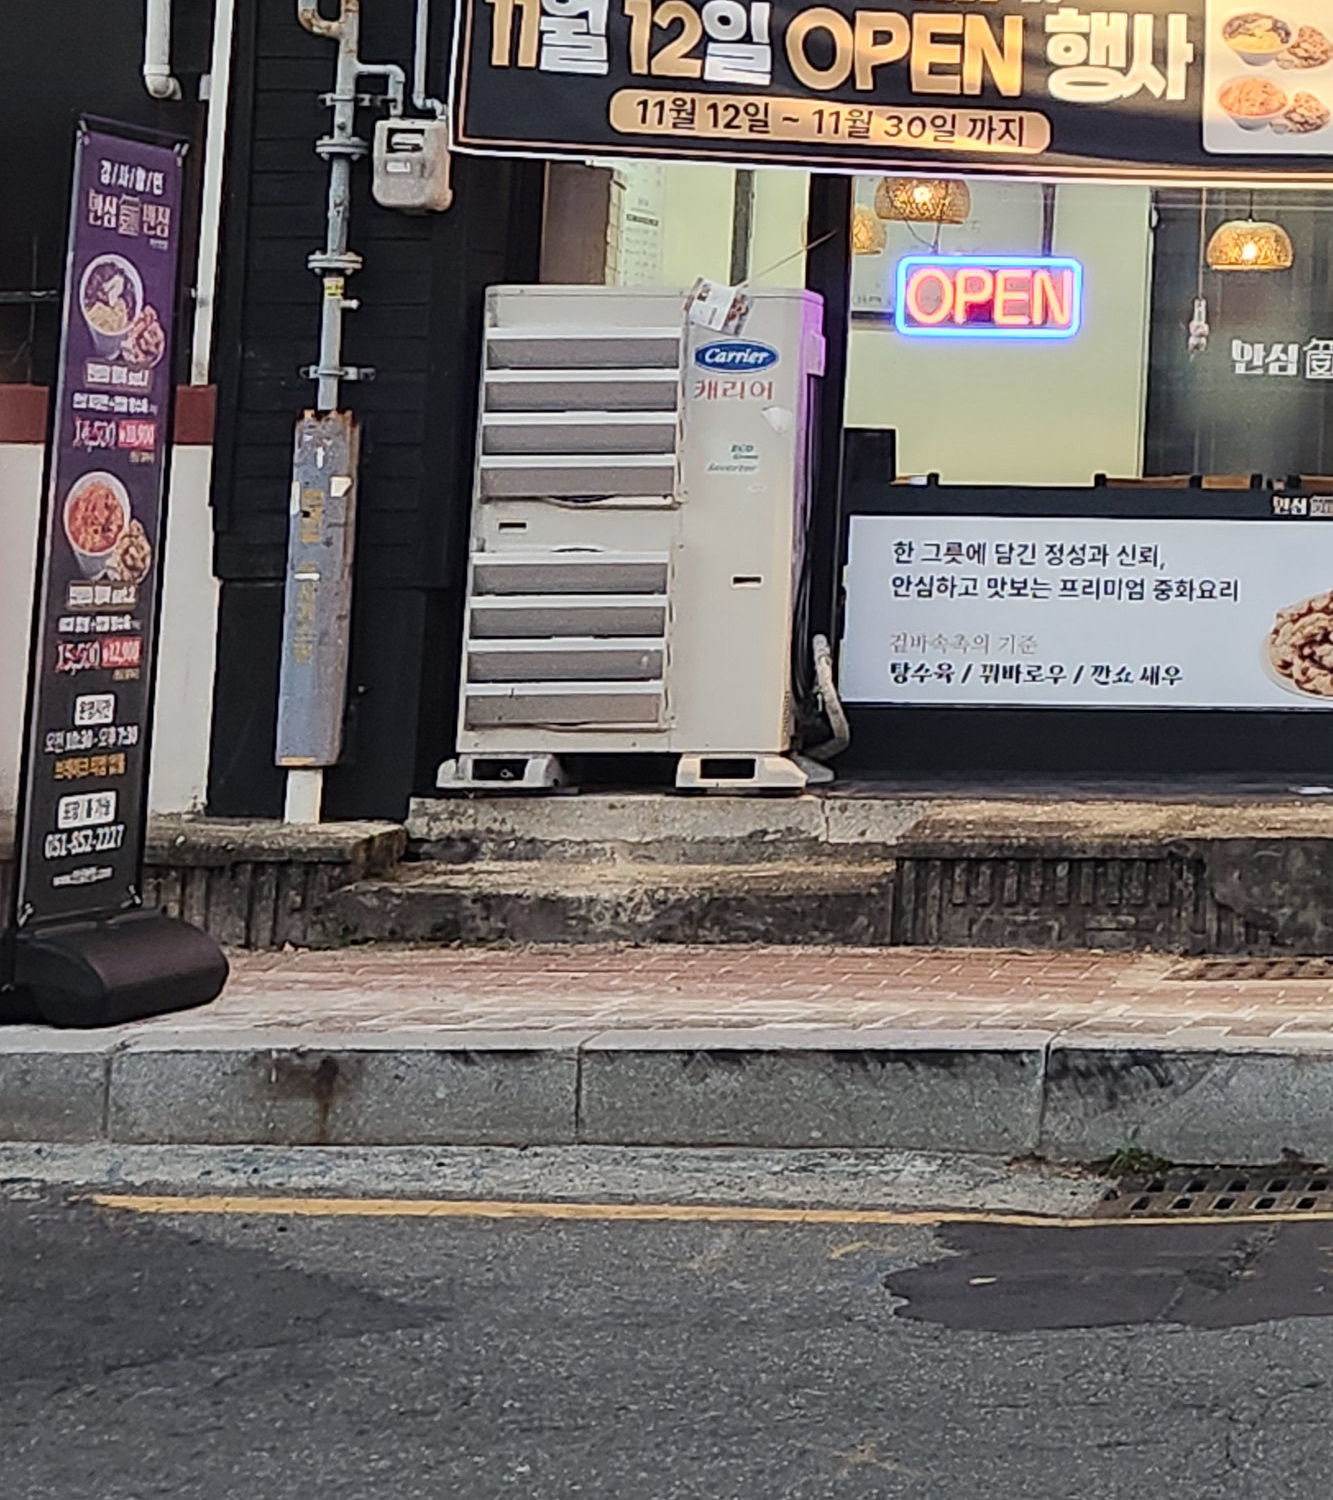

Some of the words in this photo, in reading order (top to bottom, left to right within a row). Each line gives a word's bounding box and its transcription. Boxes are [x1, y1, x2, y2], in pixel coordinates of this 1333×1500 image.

[785, 6, 1024, 98] OPEN
[1045, 6, 1195, 103] 행사
[636, 97, 697, 130] 11월
[706, 101, 772, 135] 12일
[811, 107, 873, 140] 11월
[884, 113, 957, 143] 30일
[967, 114, 1026, 148] 까지
[906, 266, 1074, 327] OPEN
[704, 348, 771, 364] Carrier
[1231, 339, 1299, 377] 안심
[693, 379, 774, 400] 캐리어
[893, 541, 915, 565] 한
[920, 541, 987, 567] 그릇에
[994, 542, 1037, 567] 담긴
[1044, 543, 1110, 568] 정성과
[1116, 543, 1167, 571] 신뢰,
[892, 575, 979, 600] 안심하고
[986, 576, 1053, 600] 맛보는
[1058, 577, 1146, 602] 프리미엄
[1152, 578, 1240, 603] 중화요리
[998, 634, 1039, 656] 기준
[890, 662, 955, 685] 탕수육
[1090, 664, 1134, 687] 깐쇼
[1139, 665, 1183, 687] 새우
